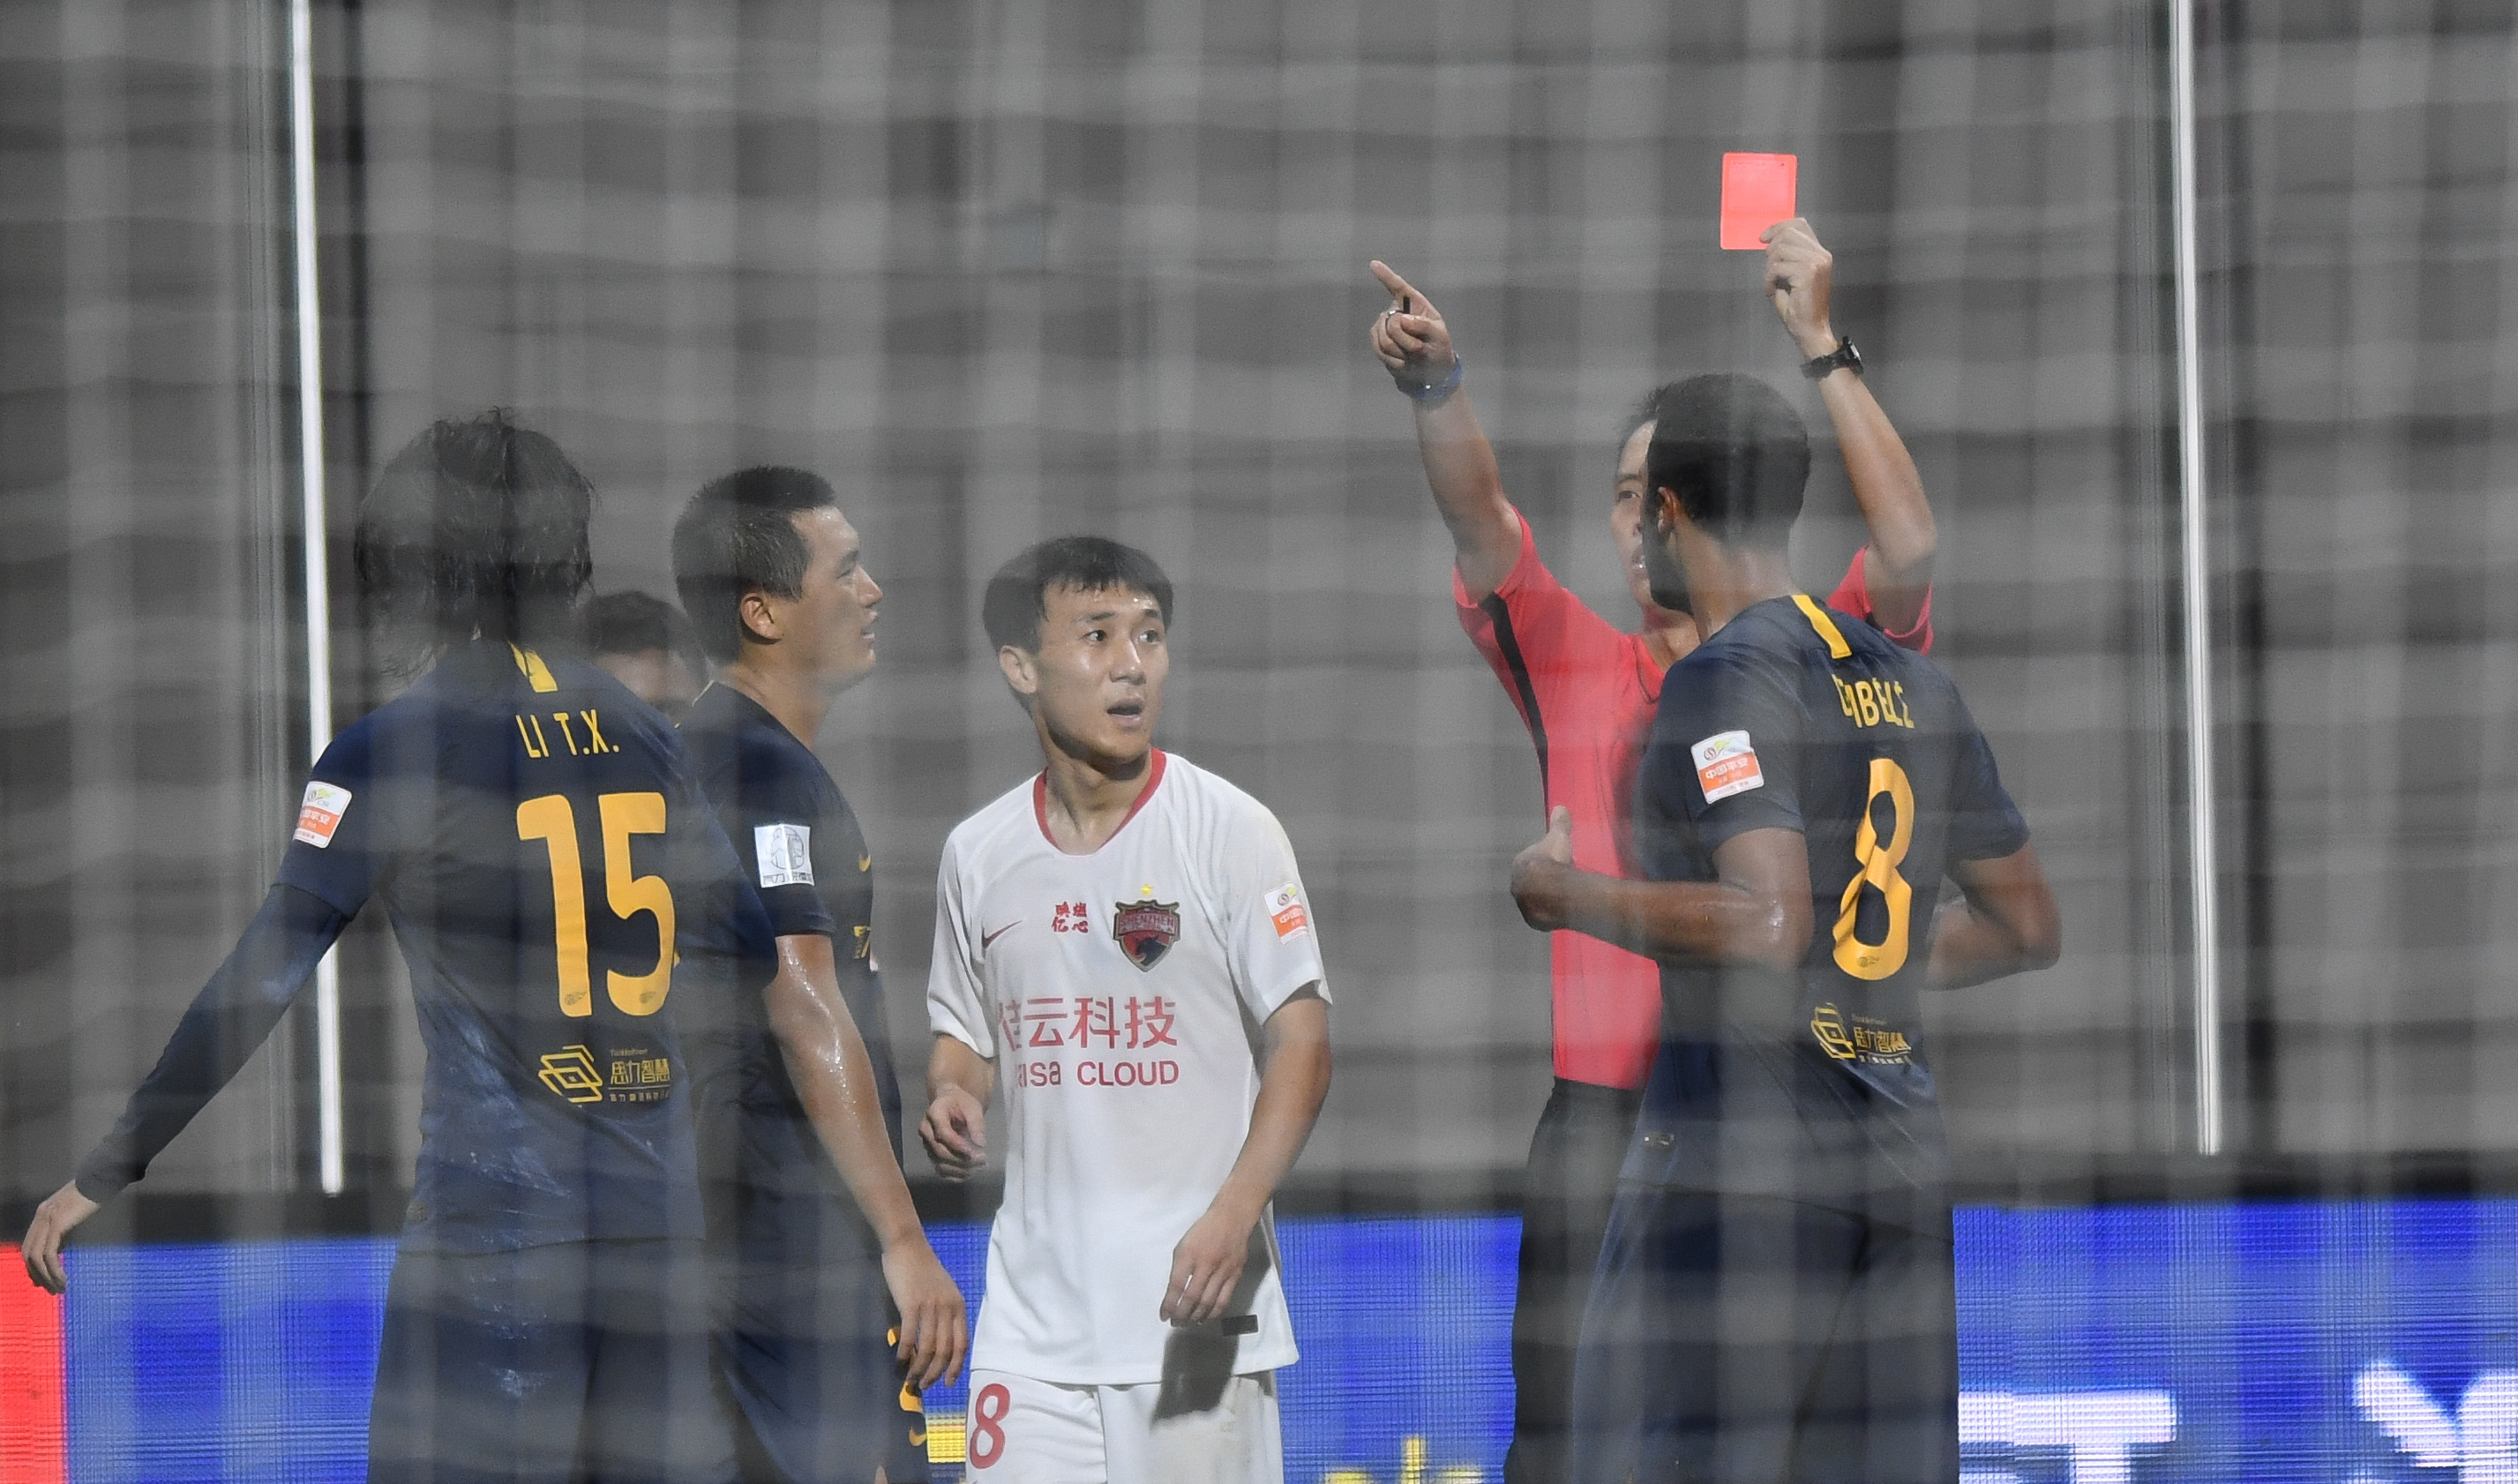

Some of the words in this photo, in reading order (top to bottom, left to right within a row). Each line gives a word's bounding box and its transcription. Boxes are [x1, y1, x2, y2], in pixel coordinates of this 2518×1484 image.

[515, 714, 550, 758] LI
[552, 708, 620, 755] T.X.
[516, 791, 676, 1016] 15
[1832, 758, 1915, 980] 8
[1076, 1060, 1180, 1087] CLOUD
